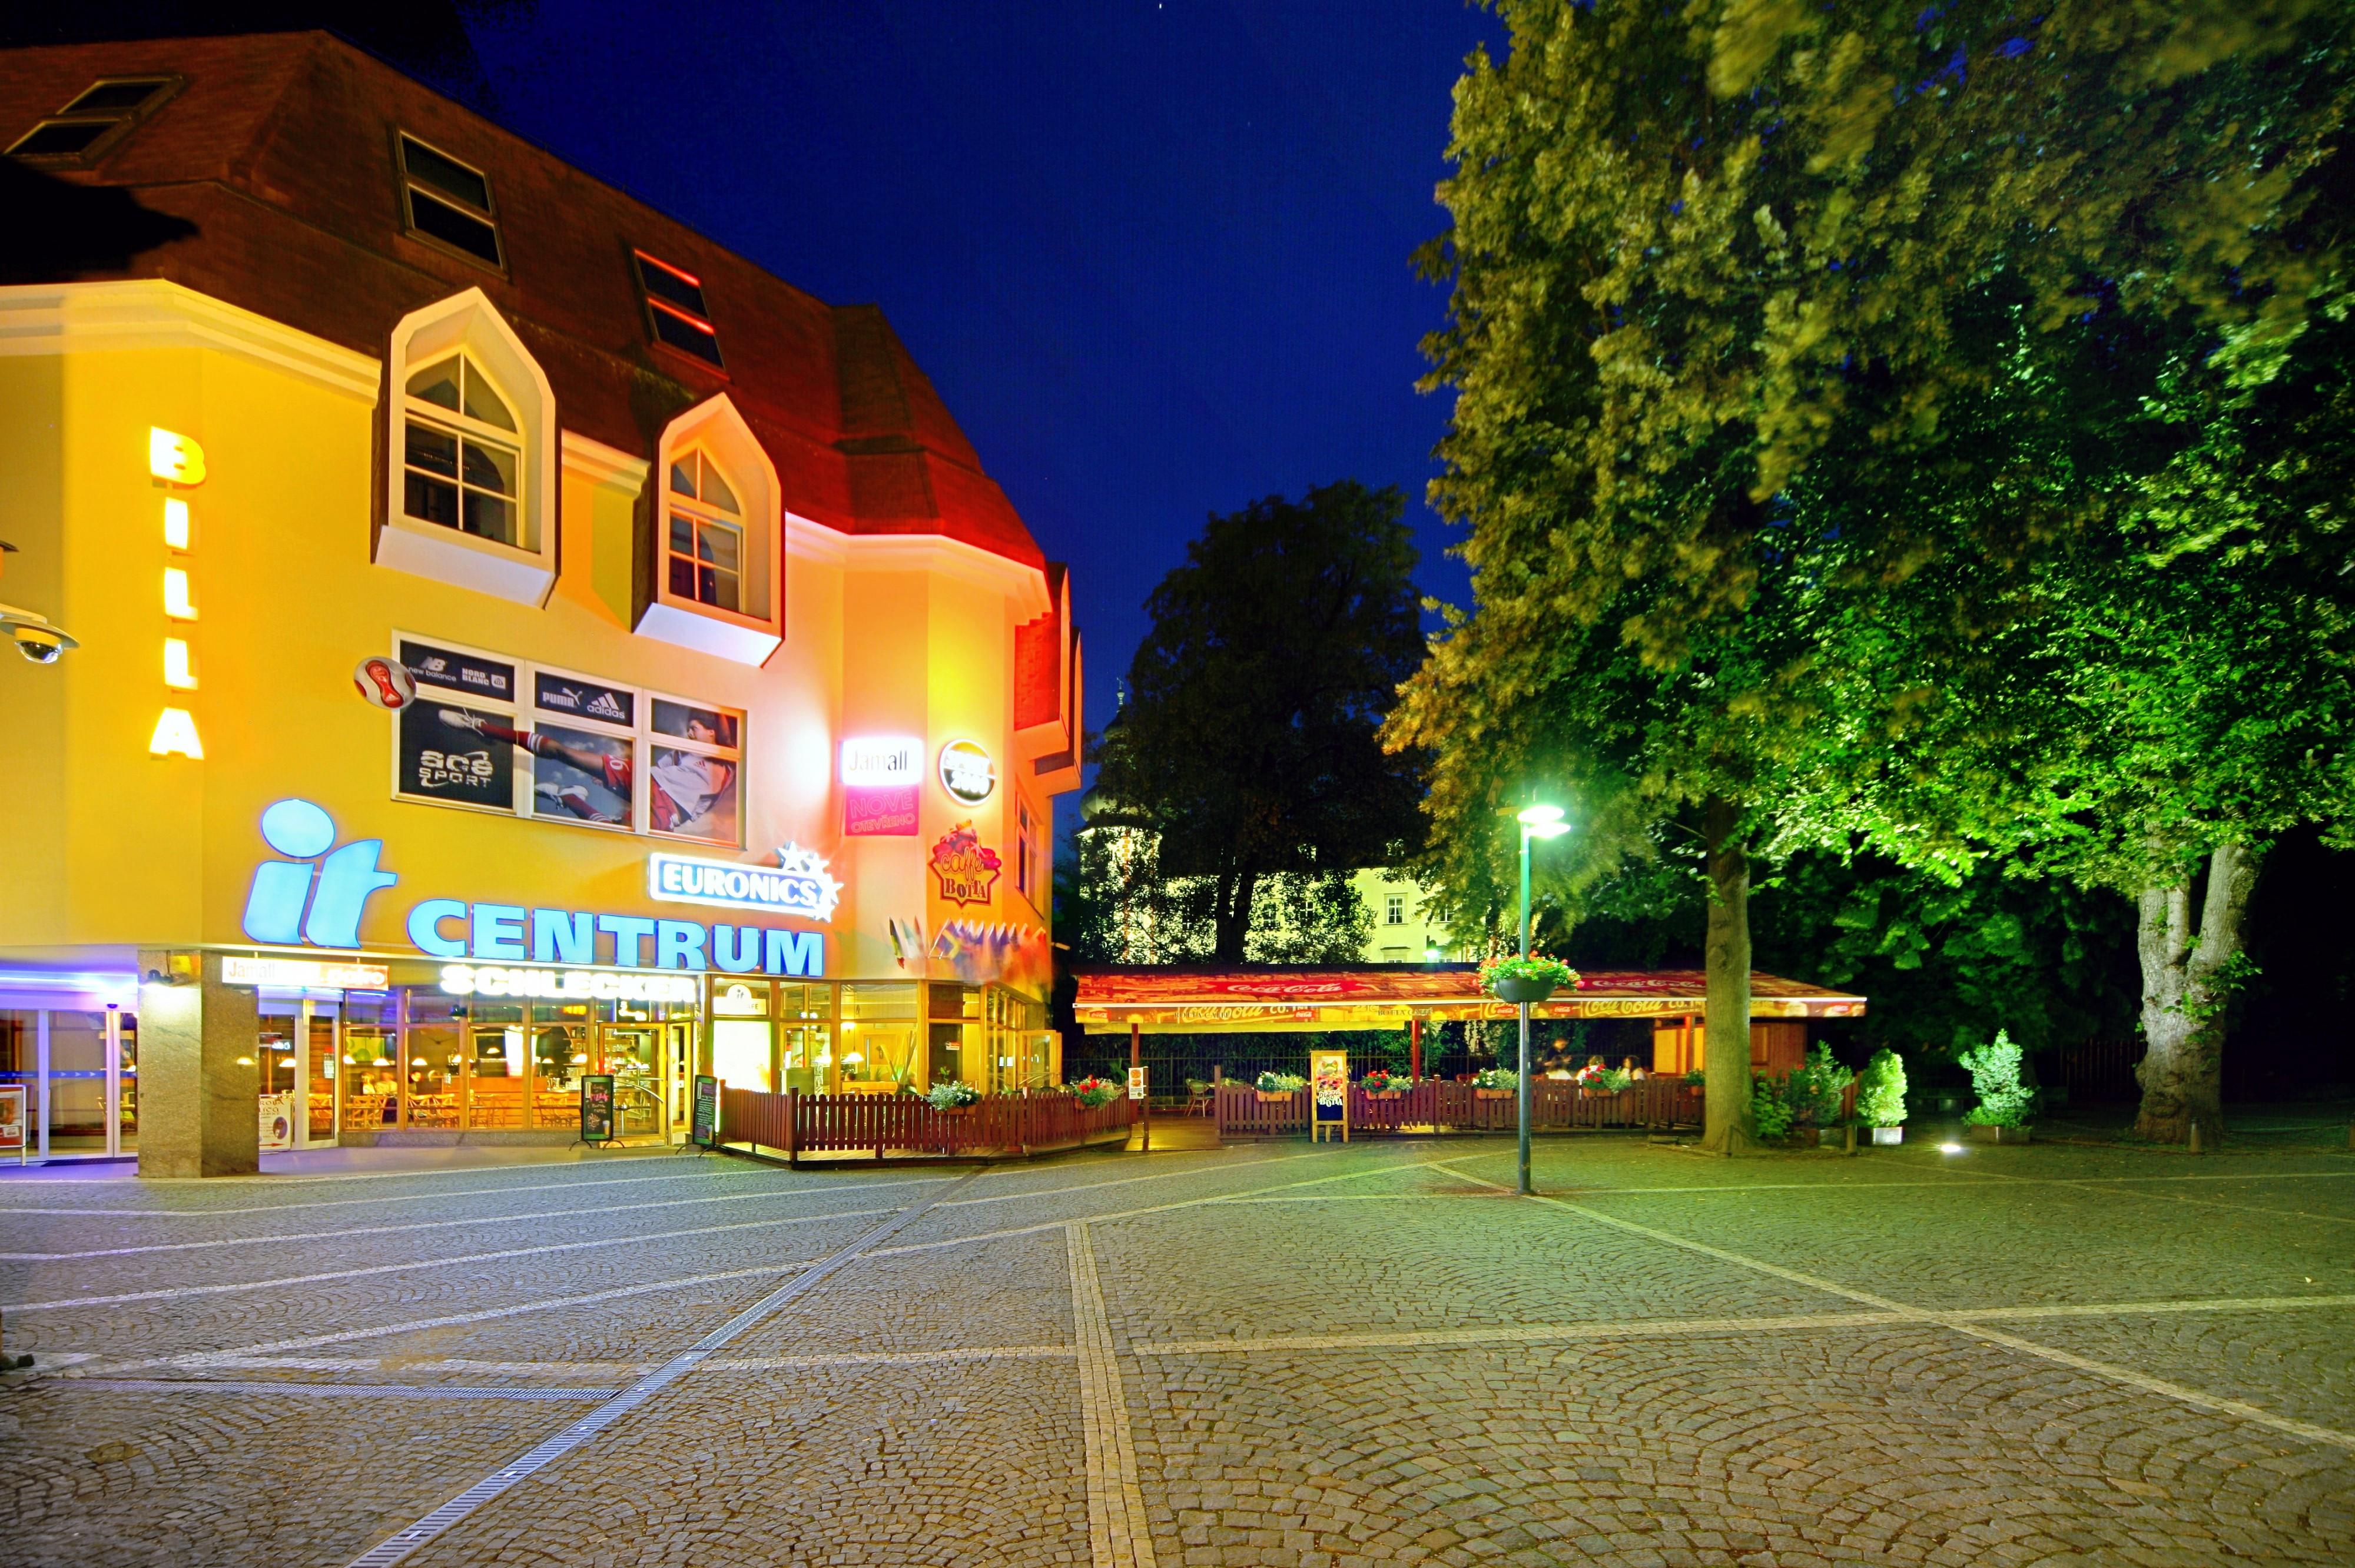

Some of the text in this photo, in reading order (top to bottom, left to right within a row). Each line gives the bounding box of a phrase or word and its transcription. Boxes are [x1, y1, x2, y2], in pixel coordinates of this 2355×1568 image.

[149, 426, 207, 760] BILLA
[425, 670, 457, 682] balance
[462, 667, 486, 679] NORD
[462, 675, 489, 685] BLANC
[586, 705, 626, 719] adidas
[849, 750, 908, 772] Jamall
[419, 767, 492, 788] SPORT
[851, 812, 916, 833] OTEVŘENO
[243, 799, 825, 978] it CENTRUM
[662, 863, 820, 908] EURONICS
[945, 878, 987, 898] BOTTA
[440, 965, 696, 1002] SCHLECKER
